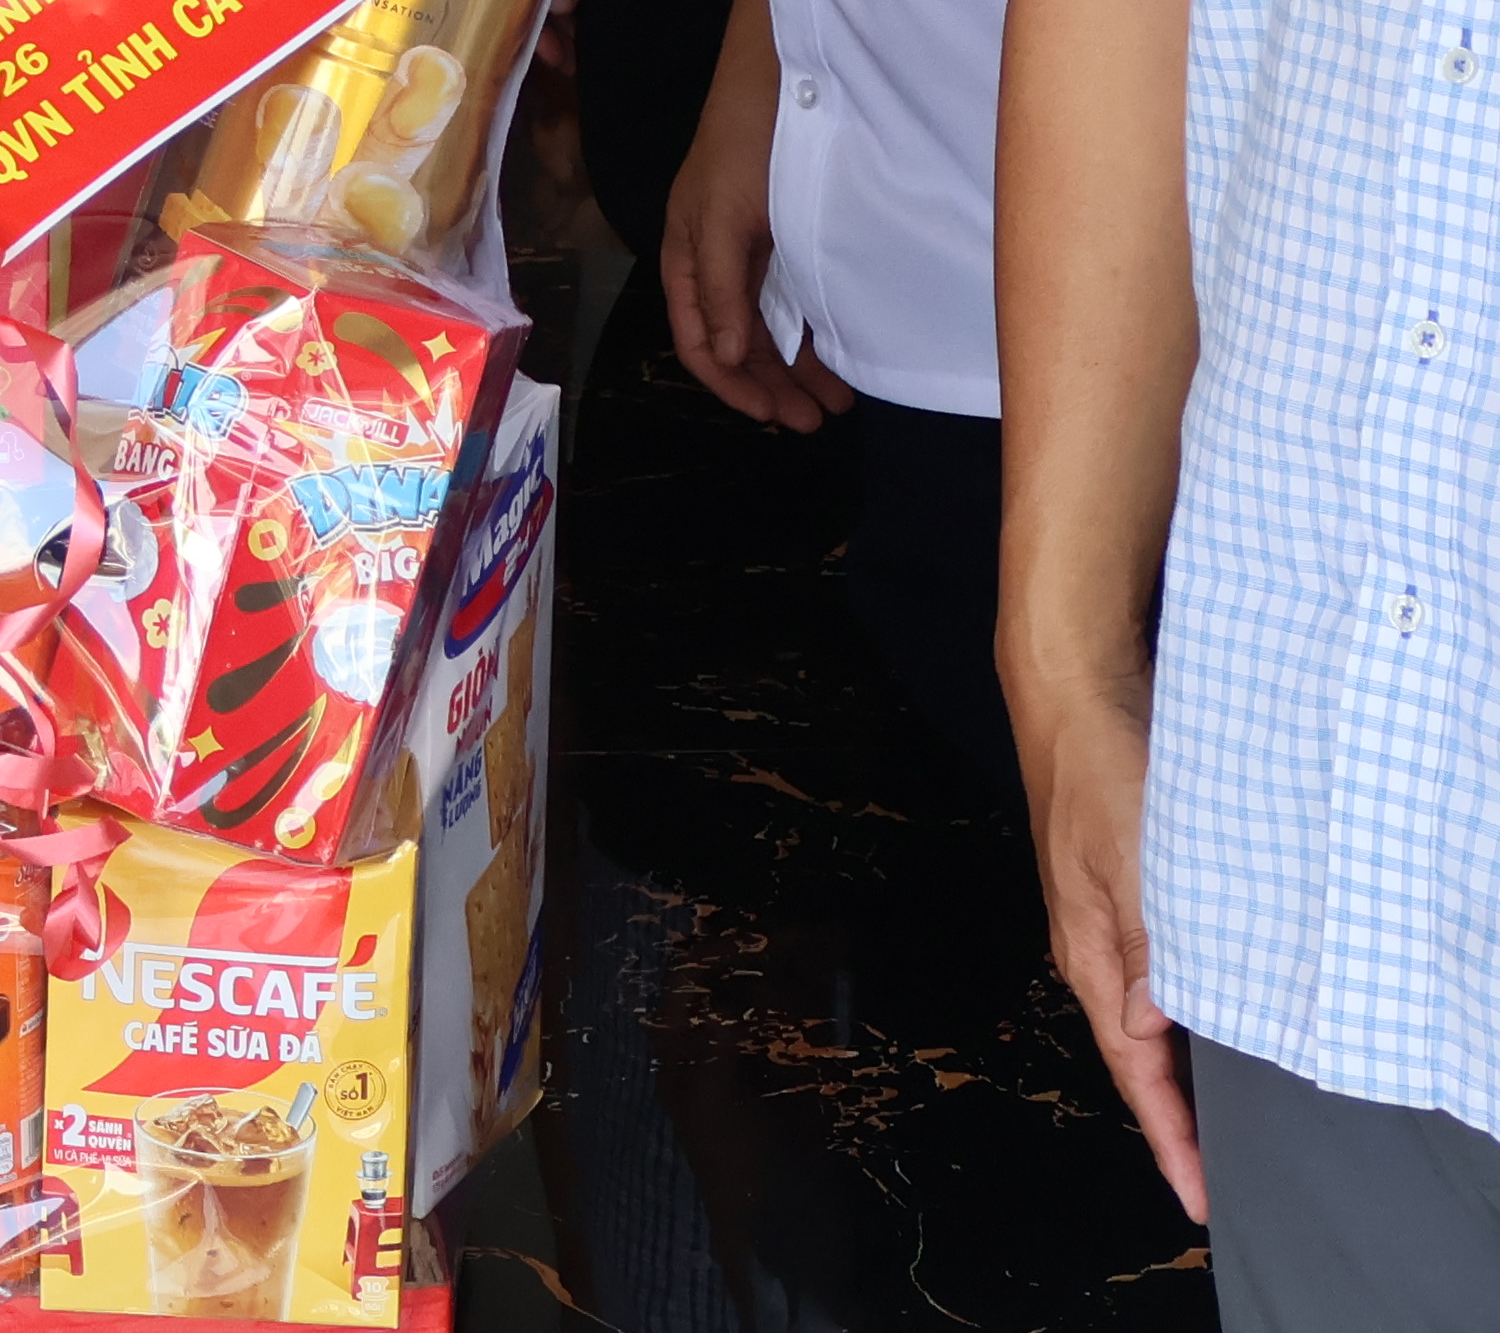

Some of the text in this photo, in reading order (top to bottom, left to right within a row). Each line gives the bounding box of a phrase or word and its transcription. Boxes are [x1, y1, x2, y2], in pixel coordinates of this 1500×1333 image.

[60, 21, 178, 115] TỈNH
[114, 439, 177, 481] BANG
[355, 546, 420, 586] BIG
[80, 934, 378, 1021] NESCAFÉ
[123, 1020, 323, 1064] CAFÉ SỮA ĐÁ
[355, 1072, 368, 1101] 1
[88, 1134, 132, 1153] QUYỆN
